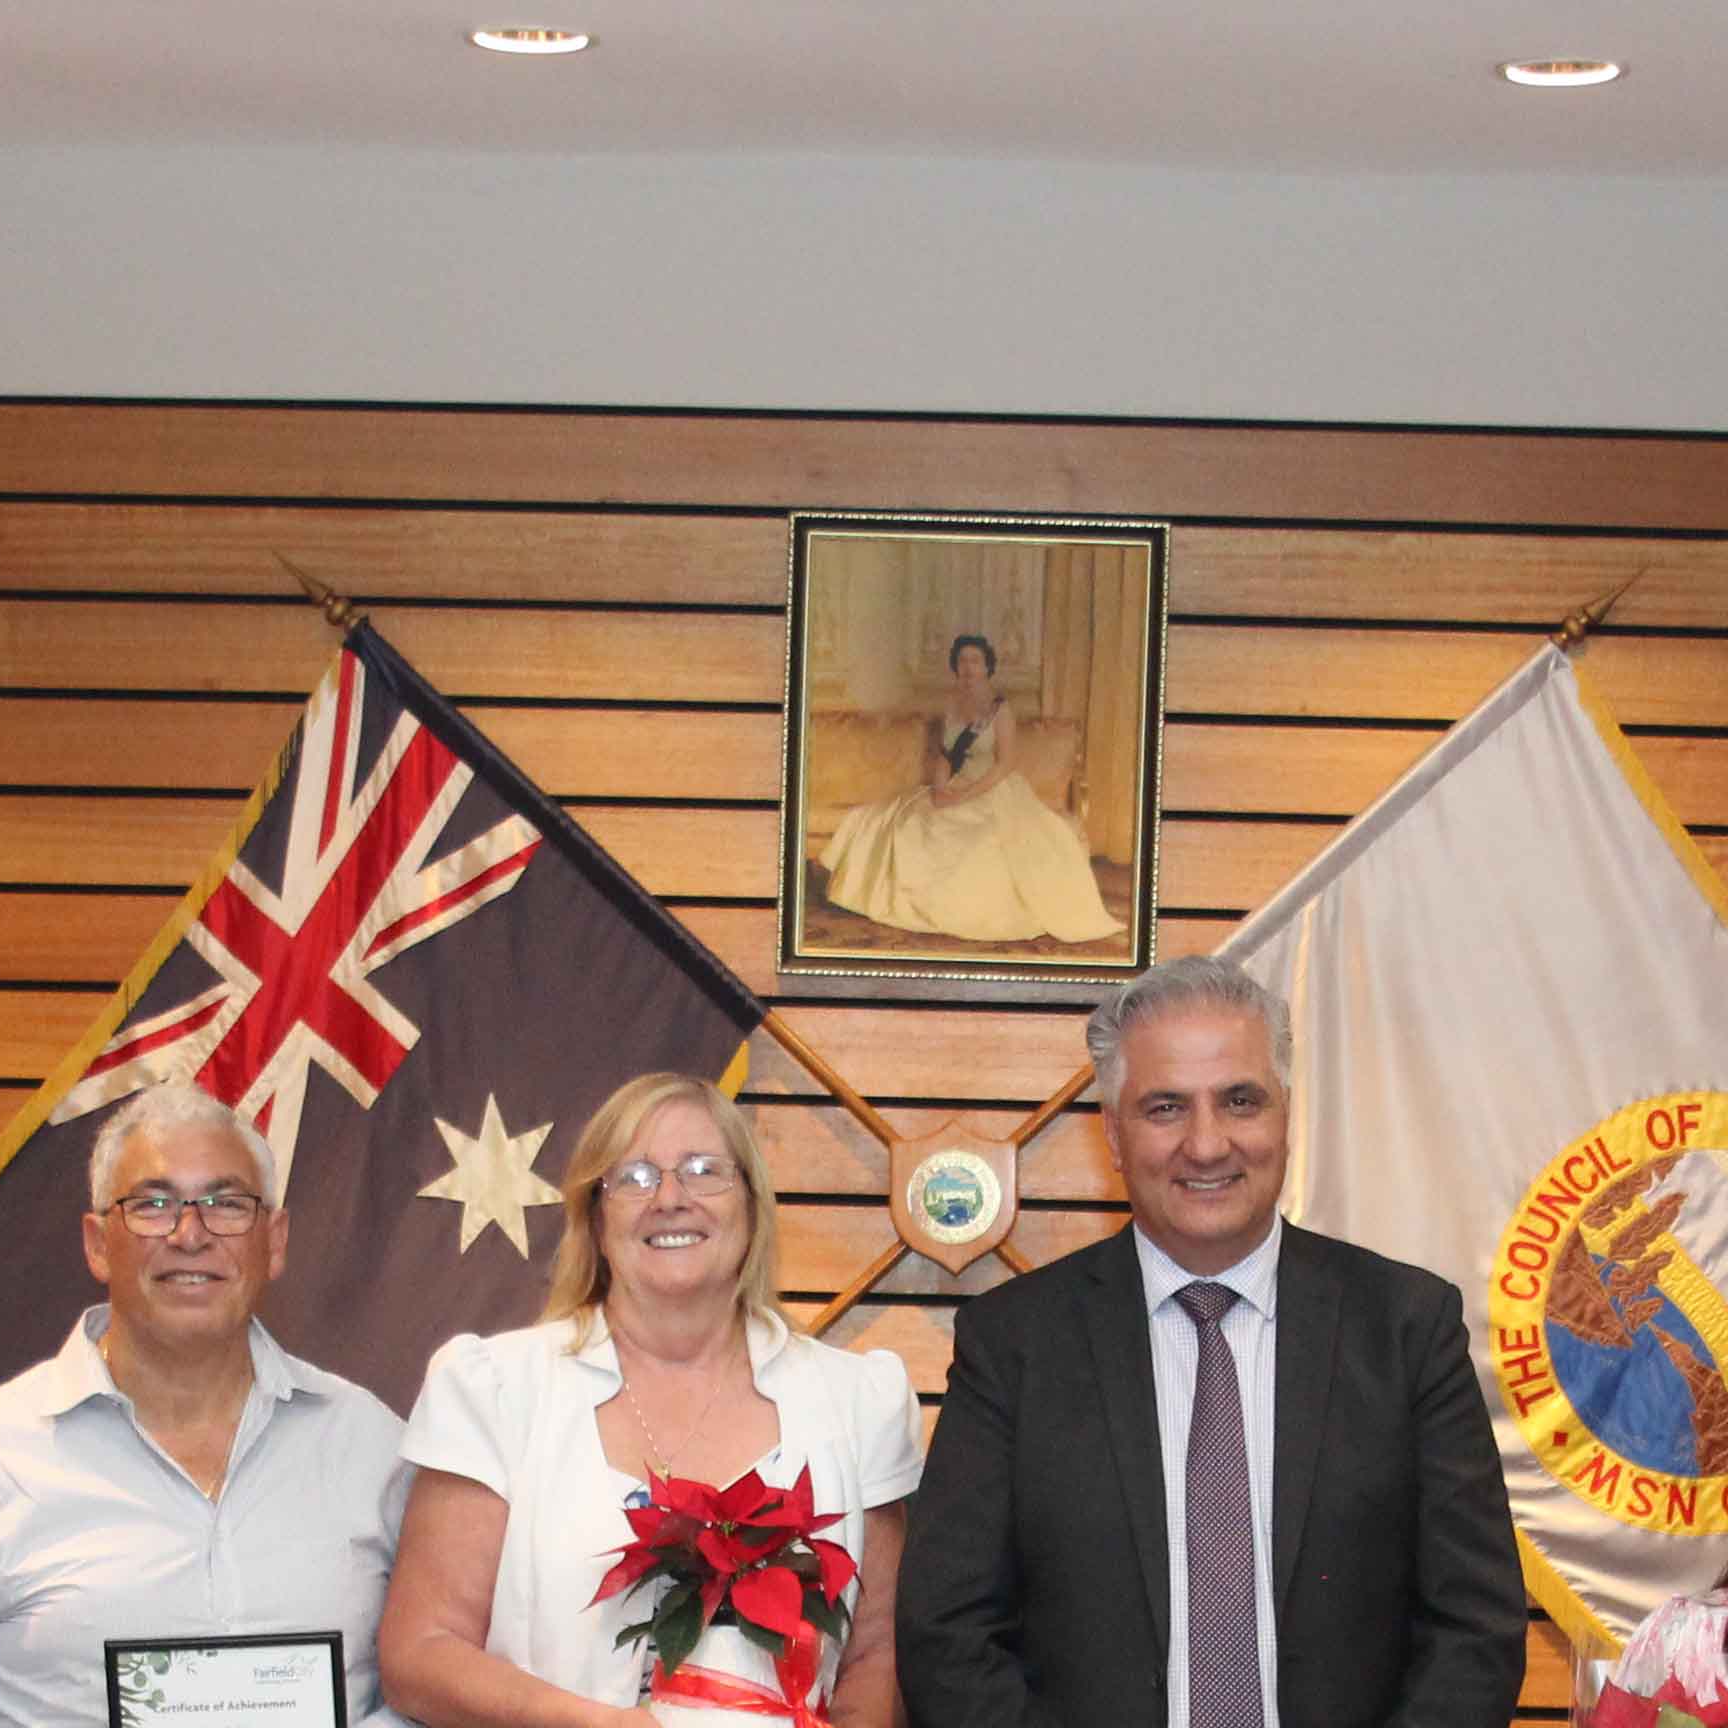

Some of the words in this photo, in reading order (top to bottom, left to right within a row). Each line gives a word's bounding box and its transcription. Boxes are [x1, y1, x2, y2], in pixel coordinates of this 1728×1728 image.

[1646, 1104, 1702, 1150] OF
[1500, 1137, 1632, 1301] COUNCIL
[1499, 1324, 1554, 1418] THE
[153, 1701, 210, 1713] Certificate
[213, 1700, 224, 1711] of
[227, 1699, 297, 1711] Achievement
